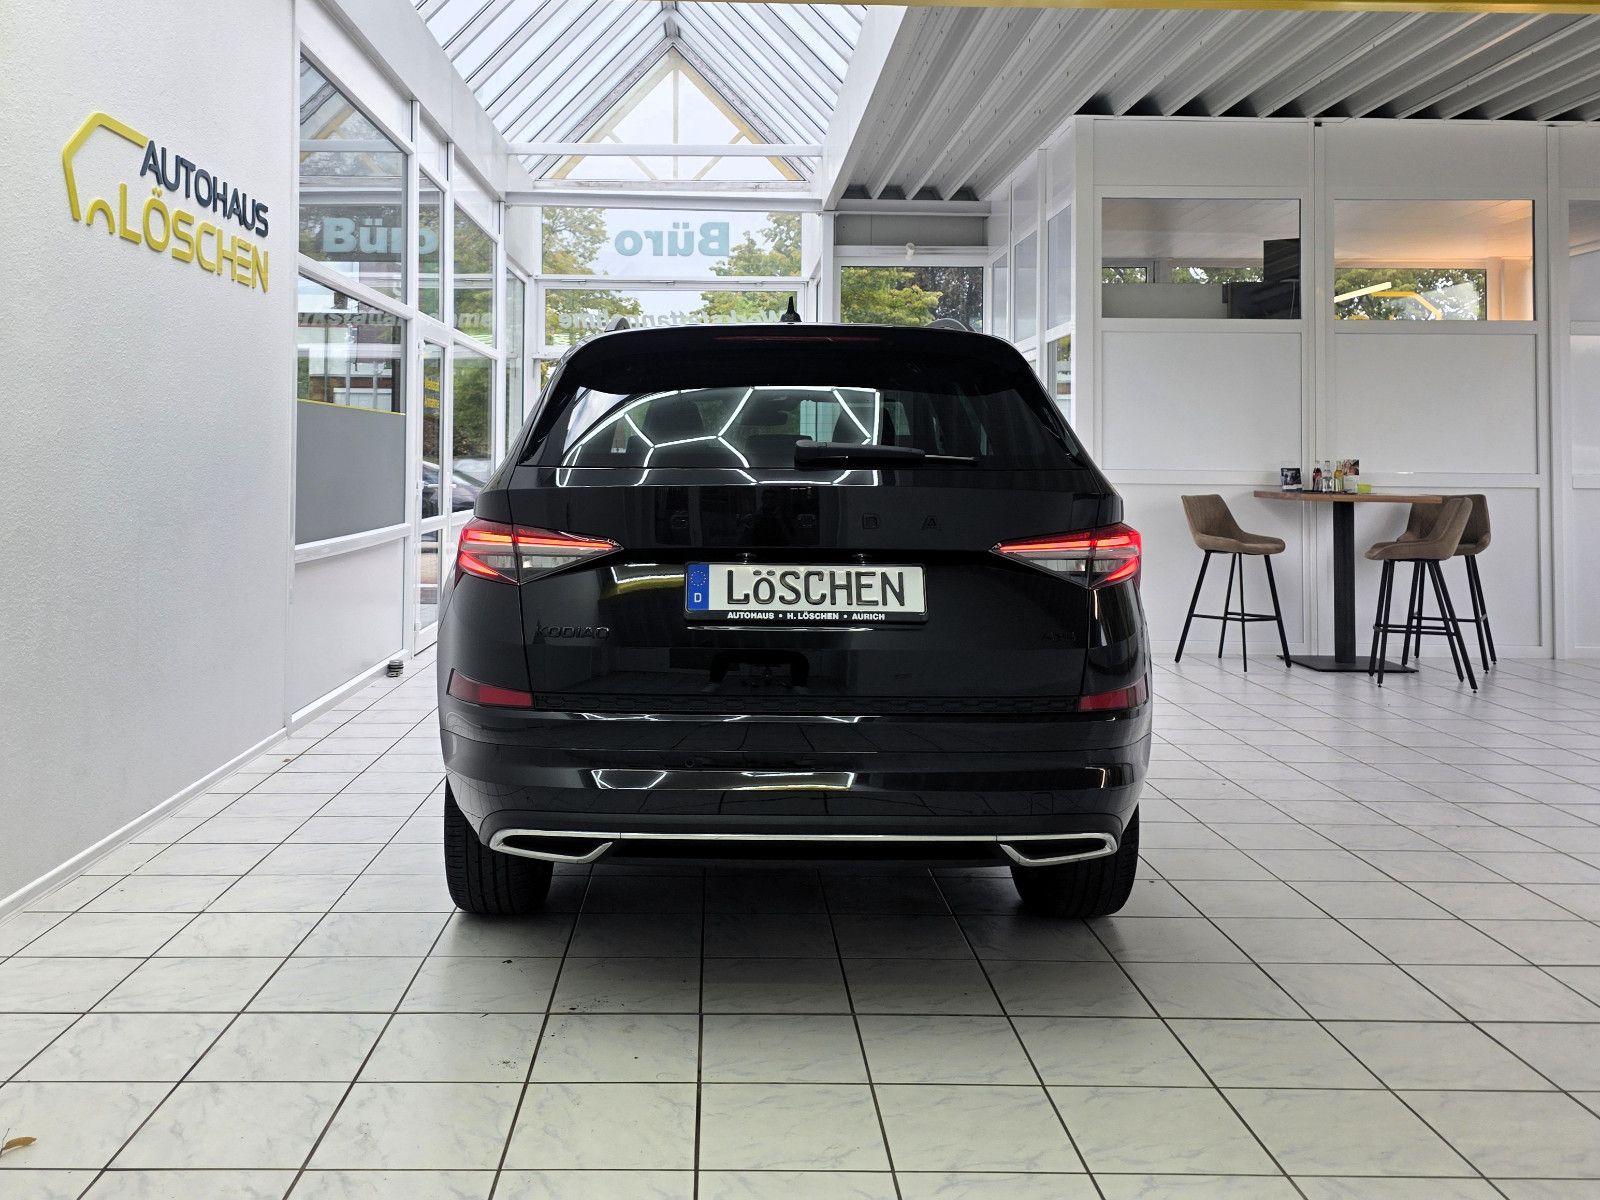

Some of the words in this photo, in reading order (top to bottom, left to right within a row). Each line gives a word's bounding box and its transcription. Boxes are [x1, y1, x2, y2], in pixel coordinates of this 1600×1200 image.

[140, 140, 268, 237] AUTOHAUS
[119, 183, 268, 293] LÖSCHEN
[323, 217, 438, 255] Büro
[694, 592, 702, 603] D
[727, 611, 775, 620] AUTOHAUS
[798, 610, 839, 620] LÖSCHEN
[852, 613, 886, 621] AURICH
